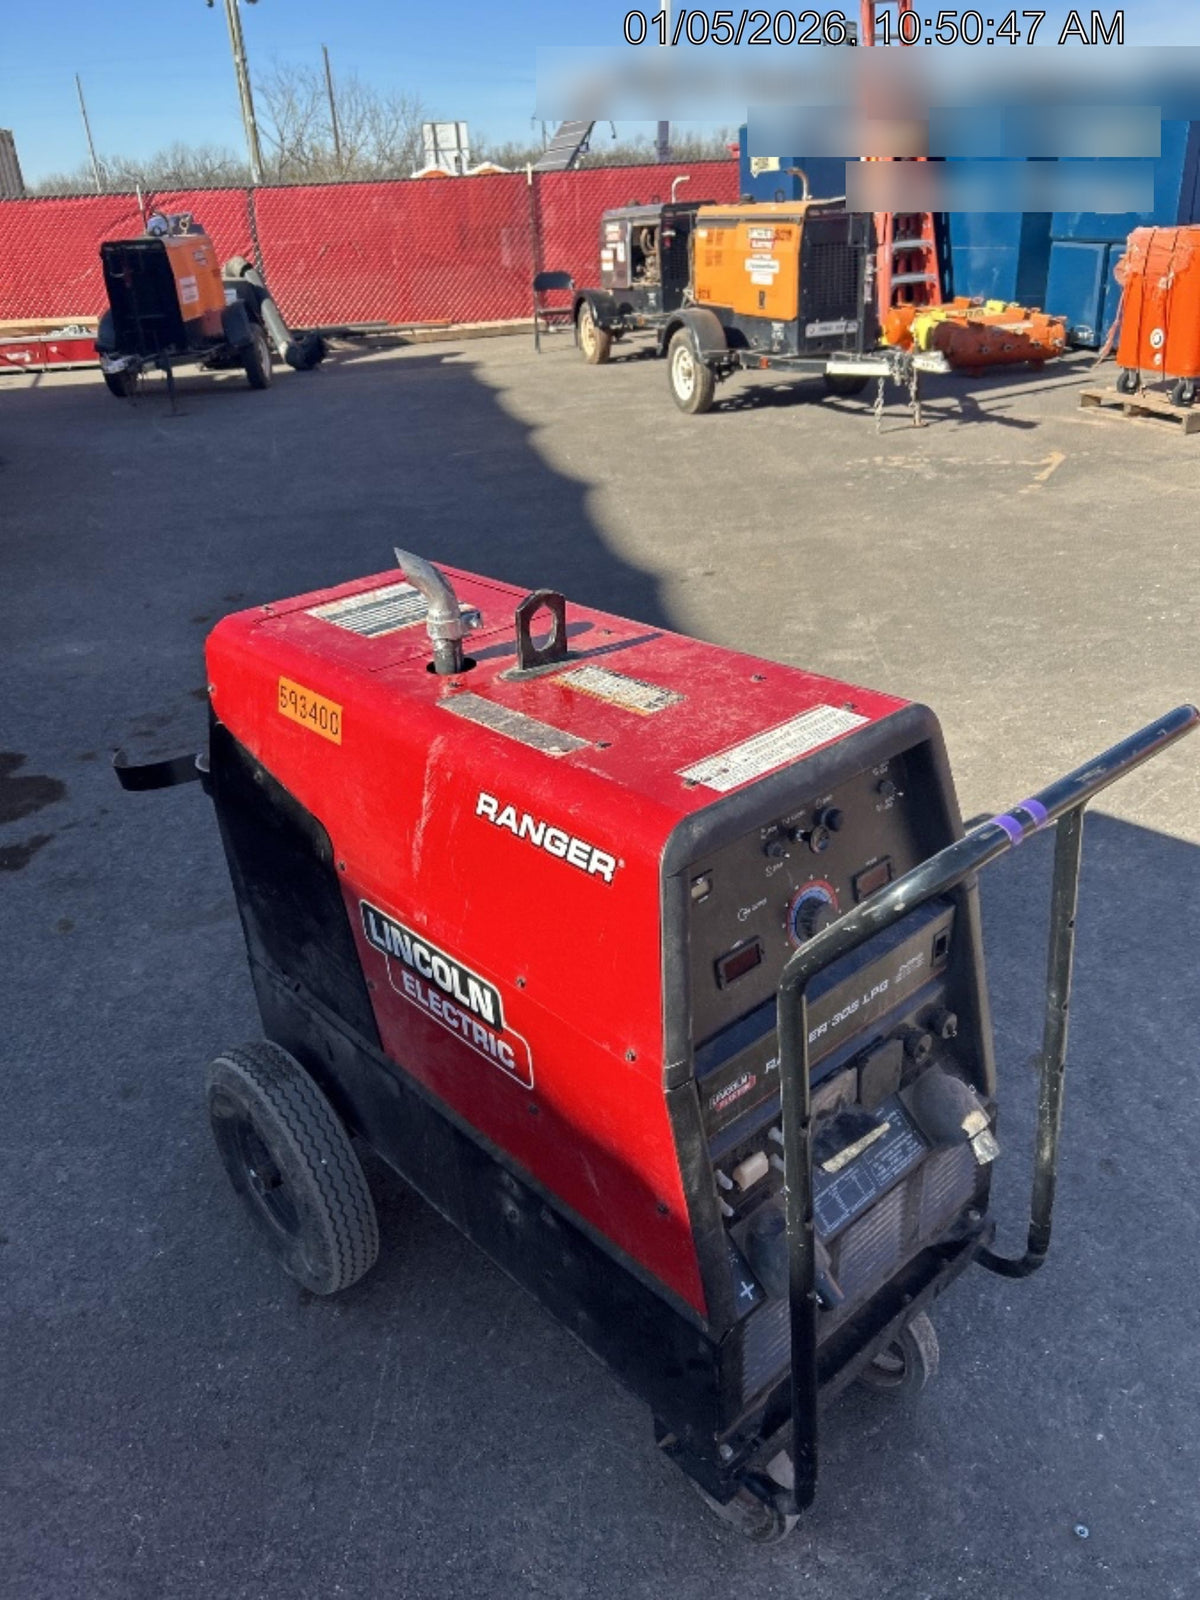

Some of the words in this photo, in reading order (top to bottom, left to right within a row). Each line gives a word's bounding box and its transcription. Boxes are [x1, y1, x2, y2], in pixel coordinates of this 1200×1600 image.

[280, 685, 339, 736] 593400
[475, 791, 617, 885] RANGER
[367, 911, 496, 1025] LINCOLN
[861, 978, 890, 1004] LPG
[401, 968, 517, 1070] ELECTRIC
